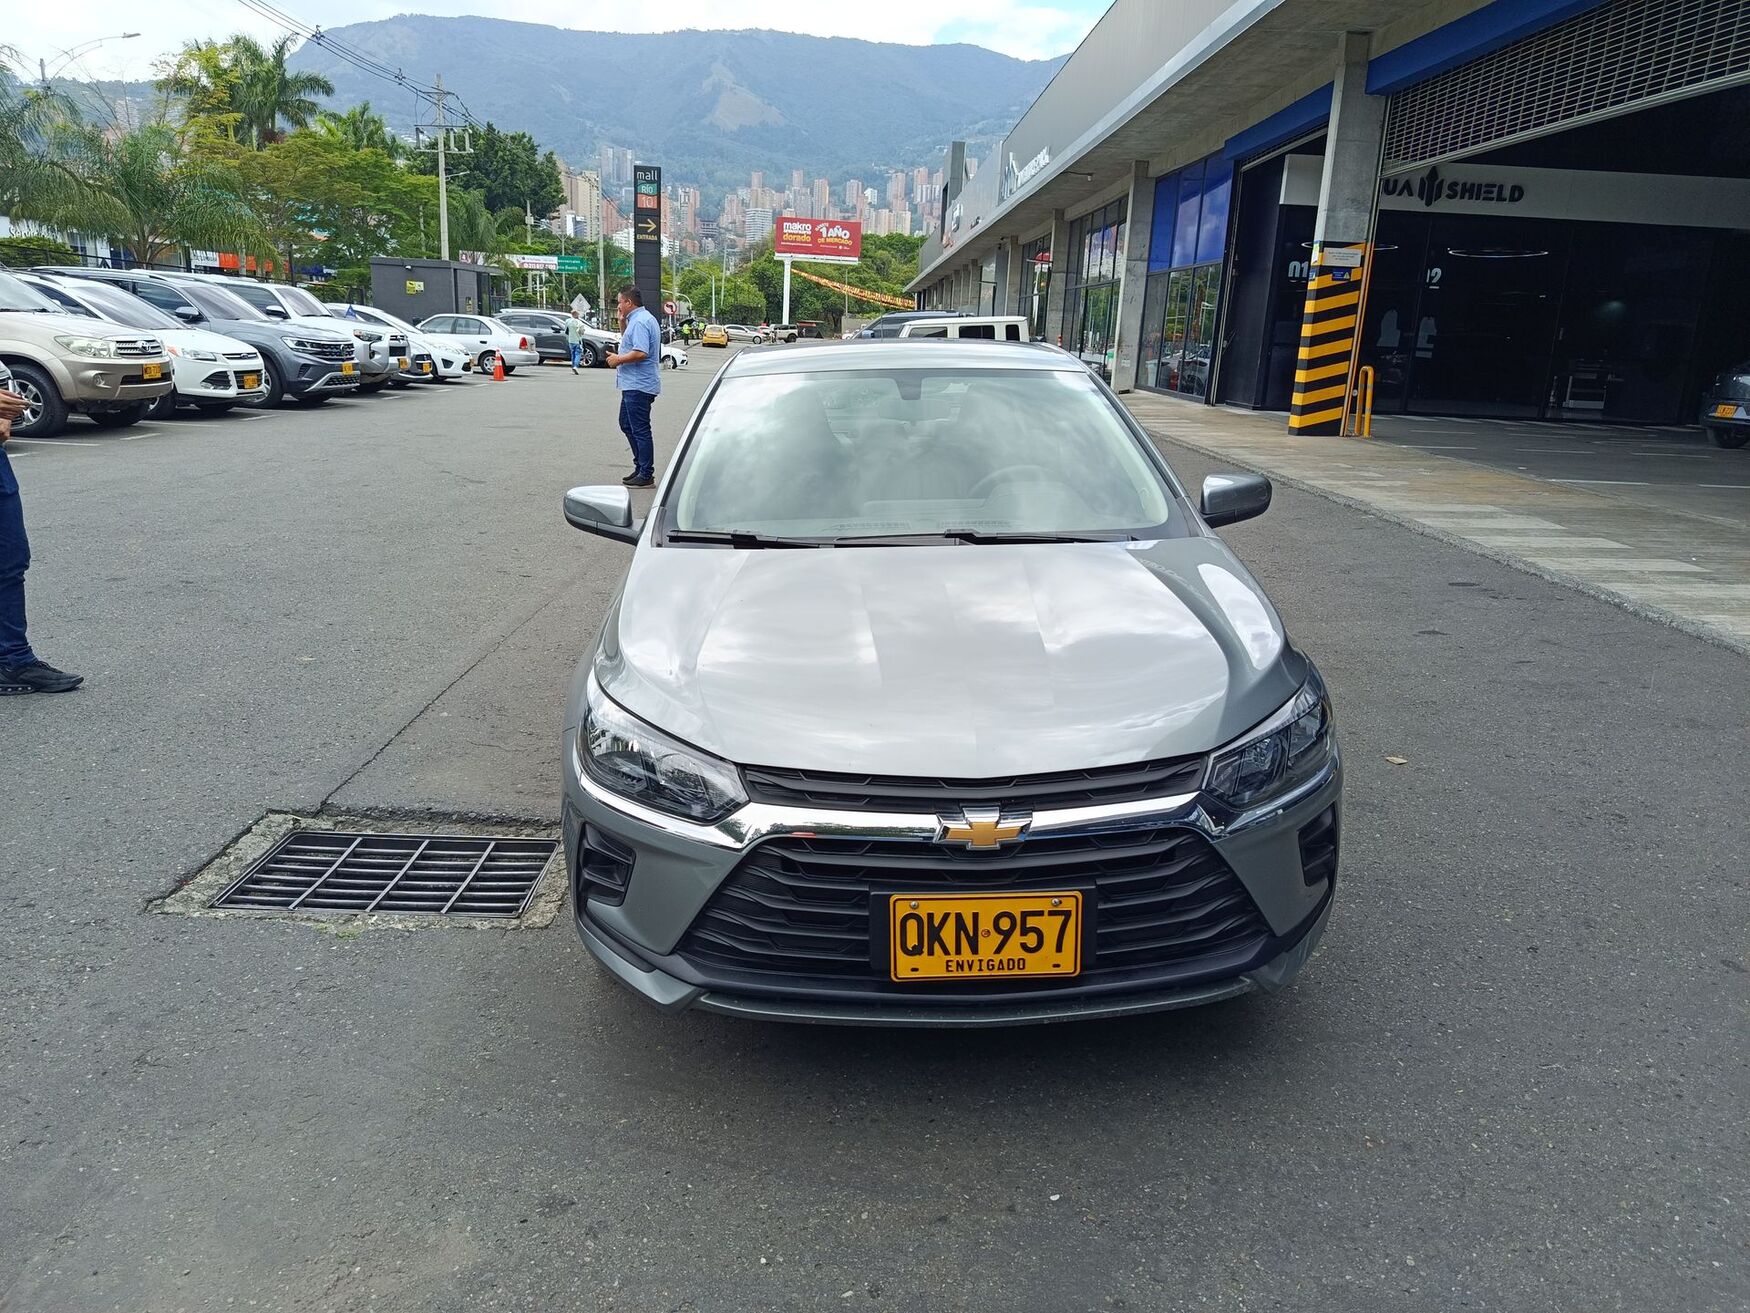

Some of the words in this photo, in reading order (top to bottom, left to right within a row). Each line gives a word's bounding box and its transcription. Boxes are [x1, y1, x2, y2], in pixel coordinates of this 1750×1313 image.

[637, 170, 657, 181] mall
[1445, 180, 1525, 203] SHIELD
[642, 196, 653, 208] 10
[783, 222, 811, 231] makro
[820, 226, 827, 238] 1
[828, 225, 850, 239] AÑO
[783, 233, 811, 242] dorado
[826, 237, 853, 246] MERCADO
[900, 912, 979, 957] QKN
[993, 910, 1072, 955] 957
[946, 958, 1026, 972] ENVIGADO
